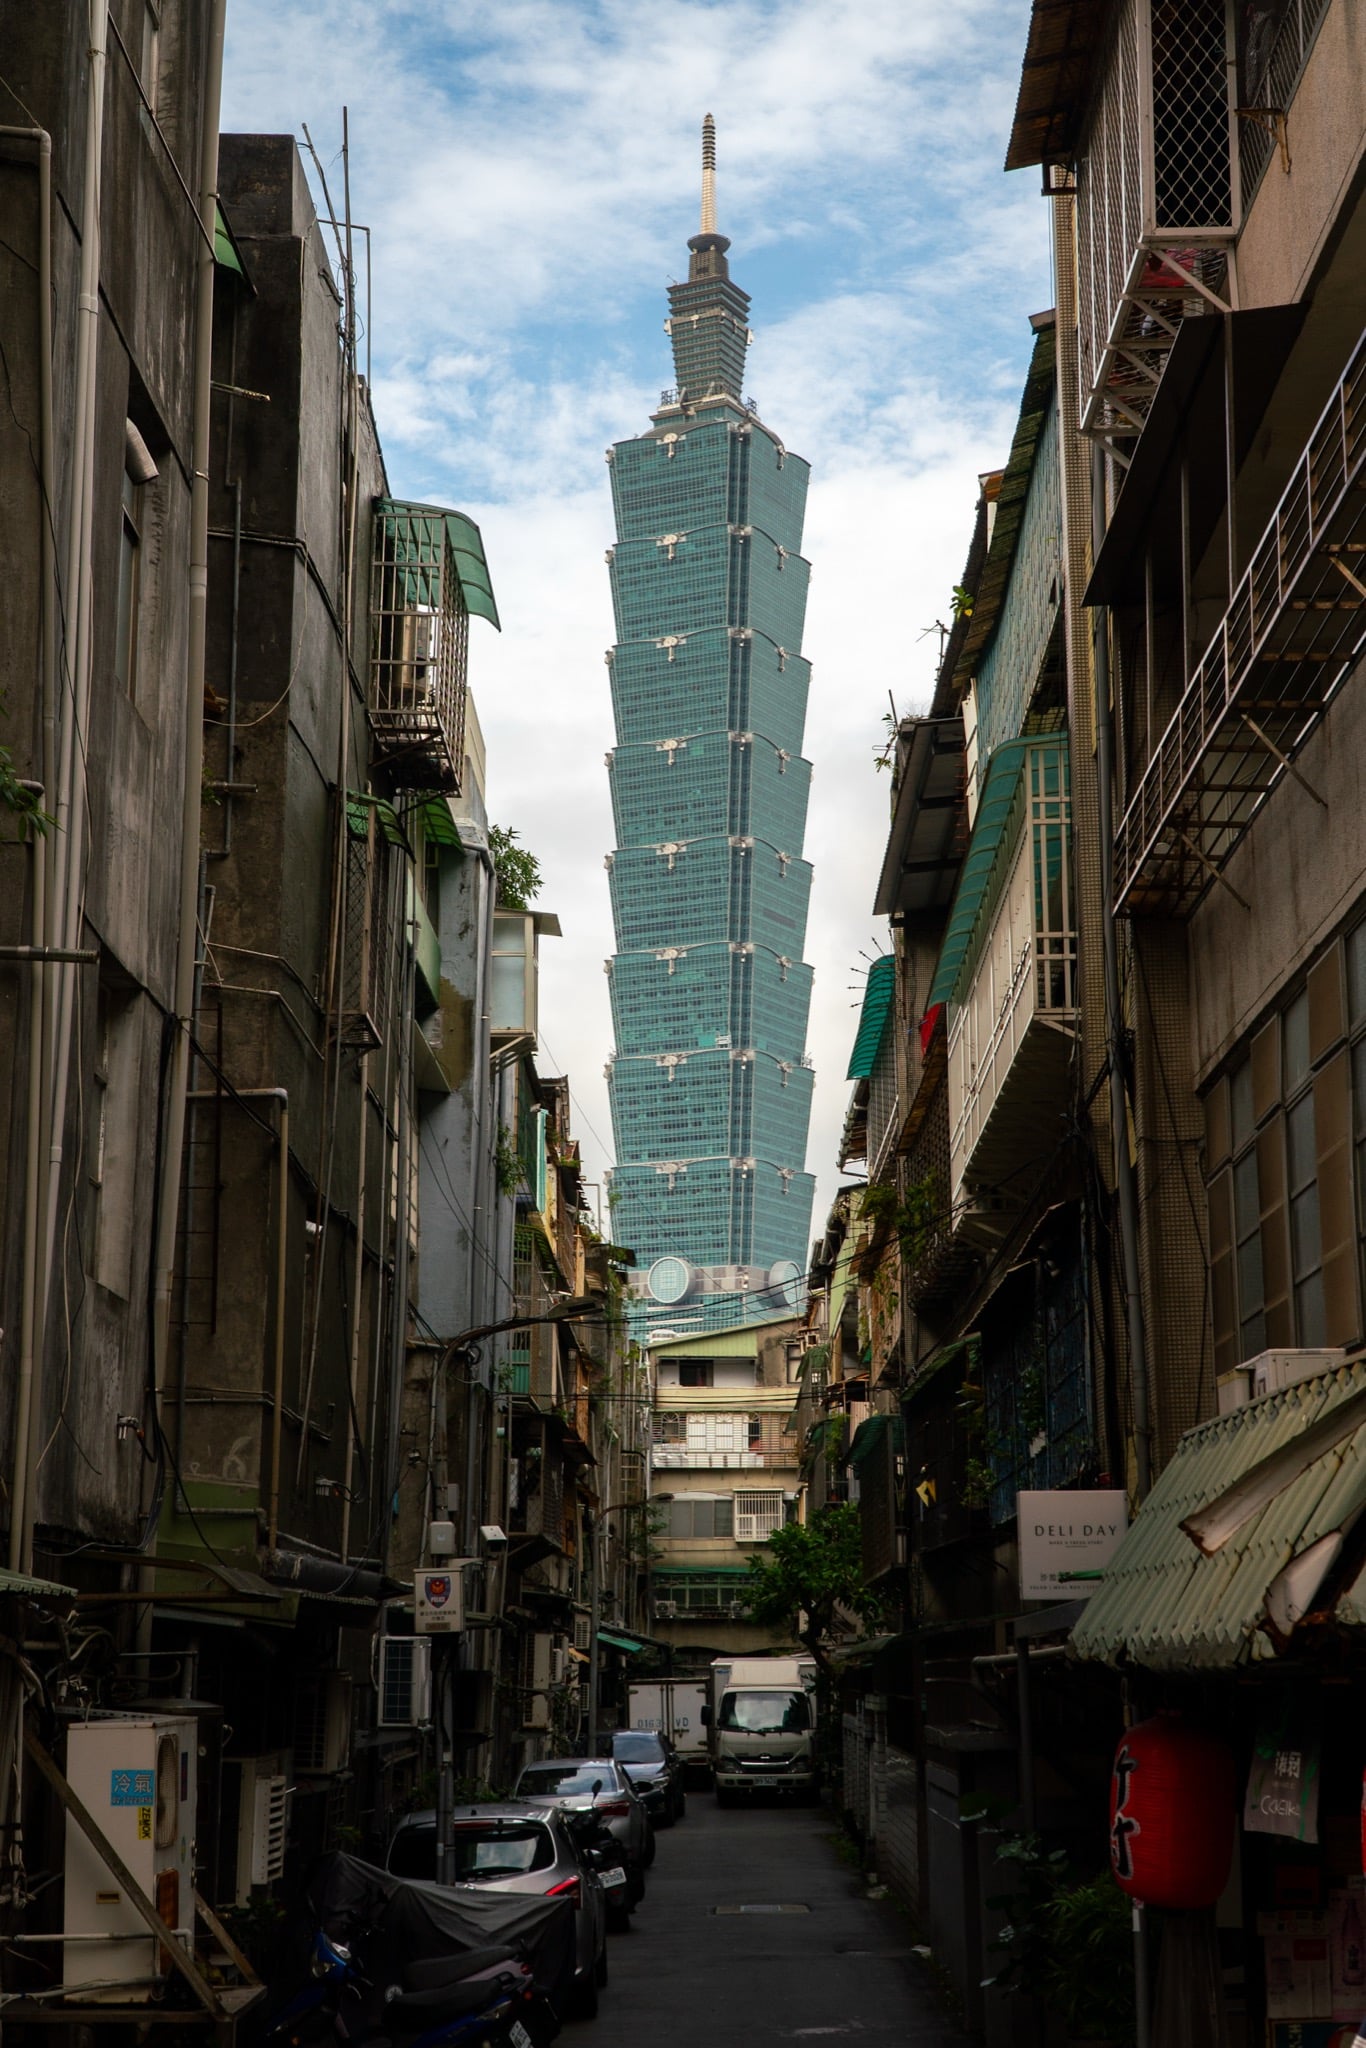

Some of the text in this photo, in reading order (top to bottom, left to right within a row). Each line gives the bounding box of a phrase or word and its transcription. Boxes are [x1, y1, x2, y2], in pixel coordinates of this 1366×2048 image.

[1034, 1525, 1117, 1537] DELI DAY
[114, 1774, 152, 1793] 冷氣
[142, 1807, 151, 1839] ZEMOK
